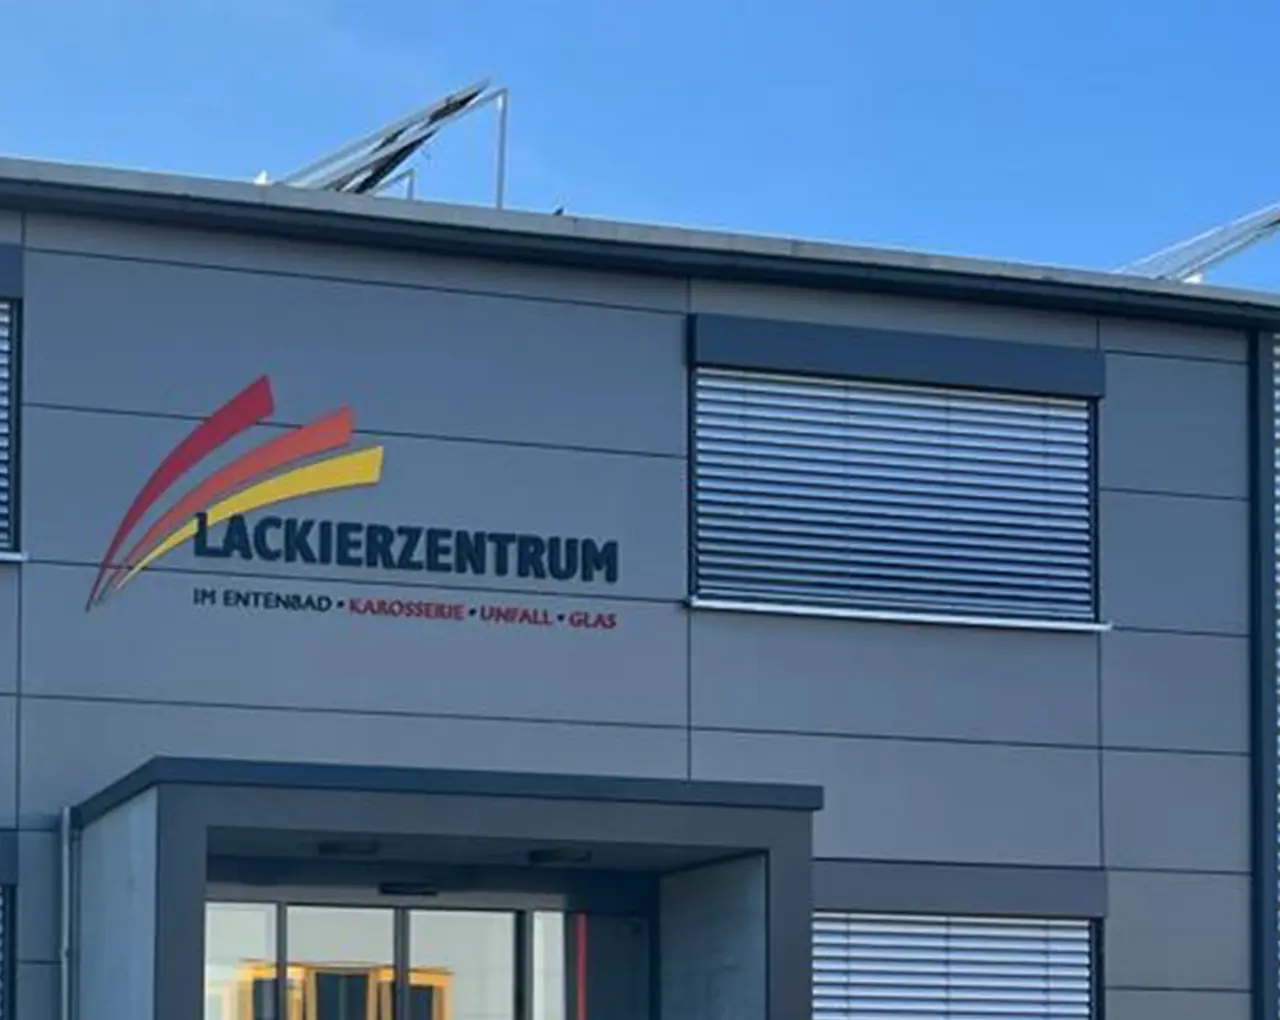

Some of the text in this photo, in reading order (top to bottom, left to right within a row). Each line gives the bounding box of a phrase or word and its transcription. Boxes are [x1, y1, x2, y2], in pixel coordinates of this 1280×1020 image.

[192, 511, 619, 584] LACKIERZENTRUM
[193, 588, 618, 629] IM ENTENBAD KAROSSERIE UNFALL GLAS
